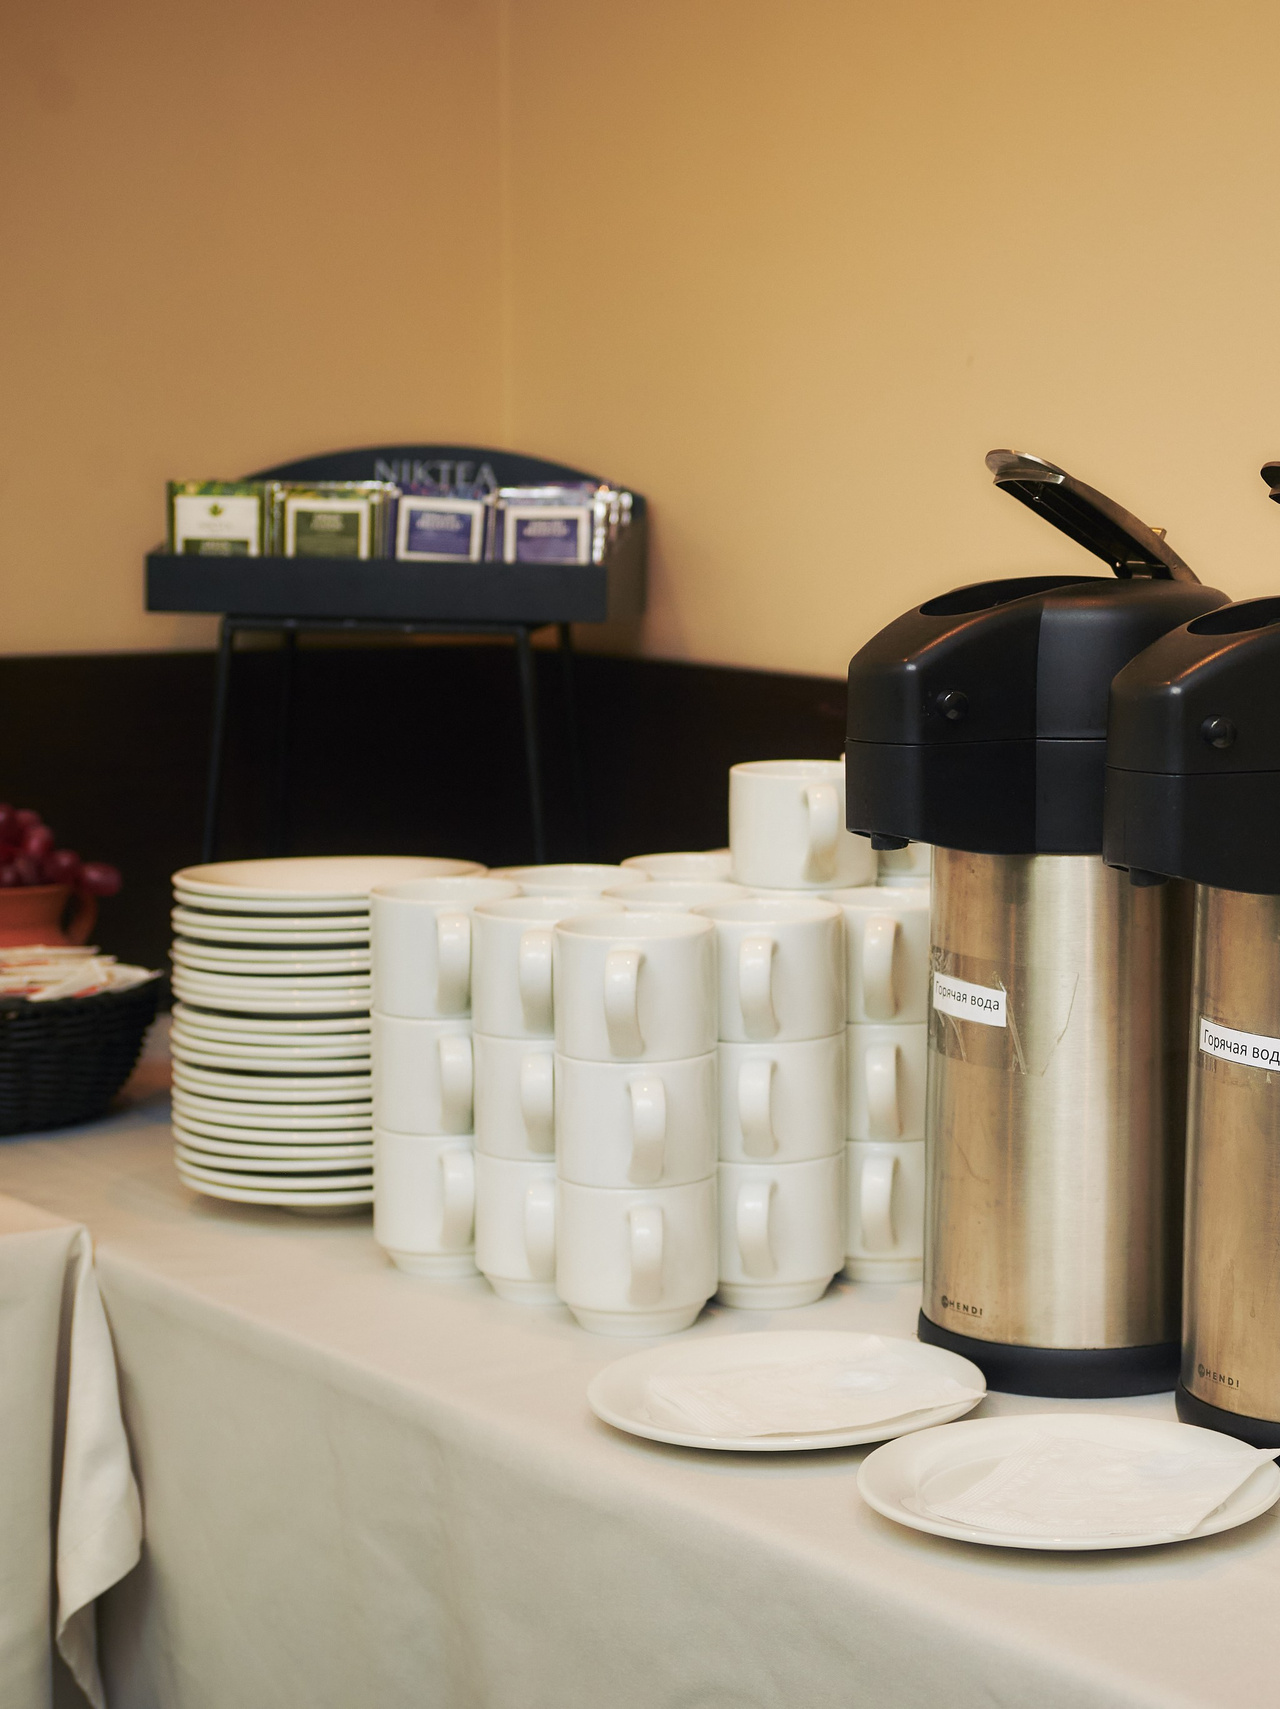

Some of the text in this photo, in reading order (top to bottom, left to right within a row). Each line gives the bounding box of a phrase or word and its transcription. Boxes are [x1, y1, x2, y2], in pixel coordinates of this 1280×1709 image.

[374, 458, 498, 489] NIKTEA
[935, 980, 1000, 1012] Горячая вода
[1204, 1029, 1248, 1057] Горячая
[949, 1300, 983, 1316] HENDI
[1205, 1368, 1239, 1388] HENDI
